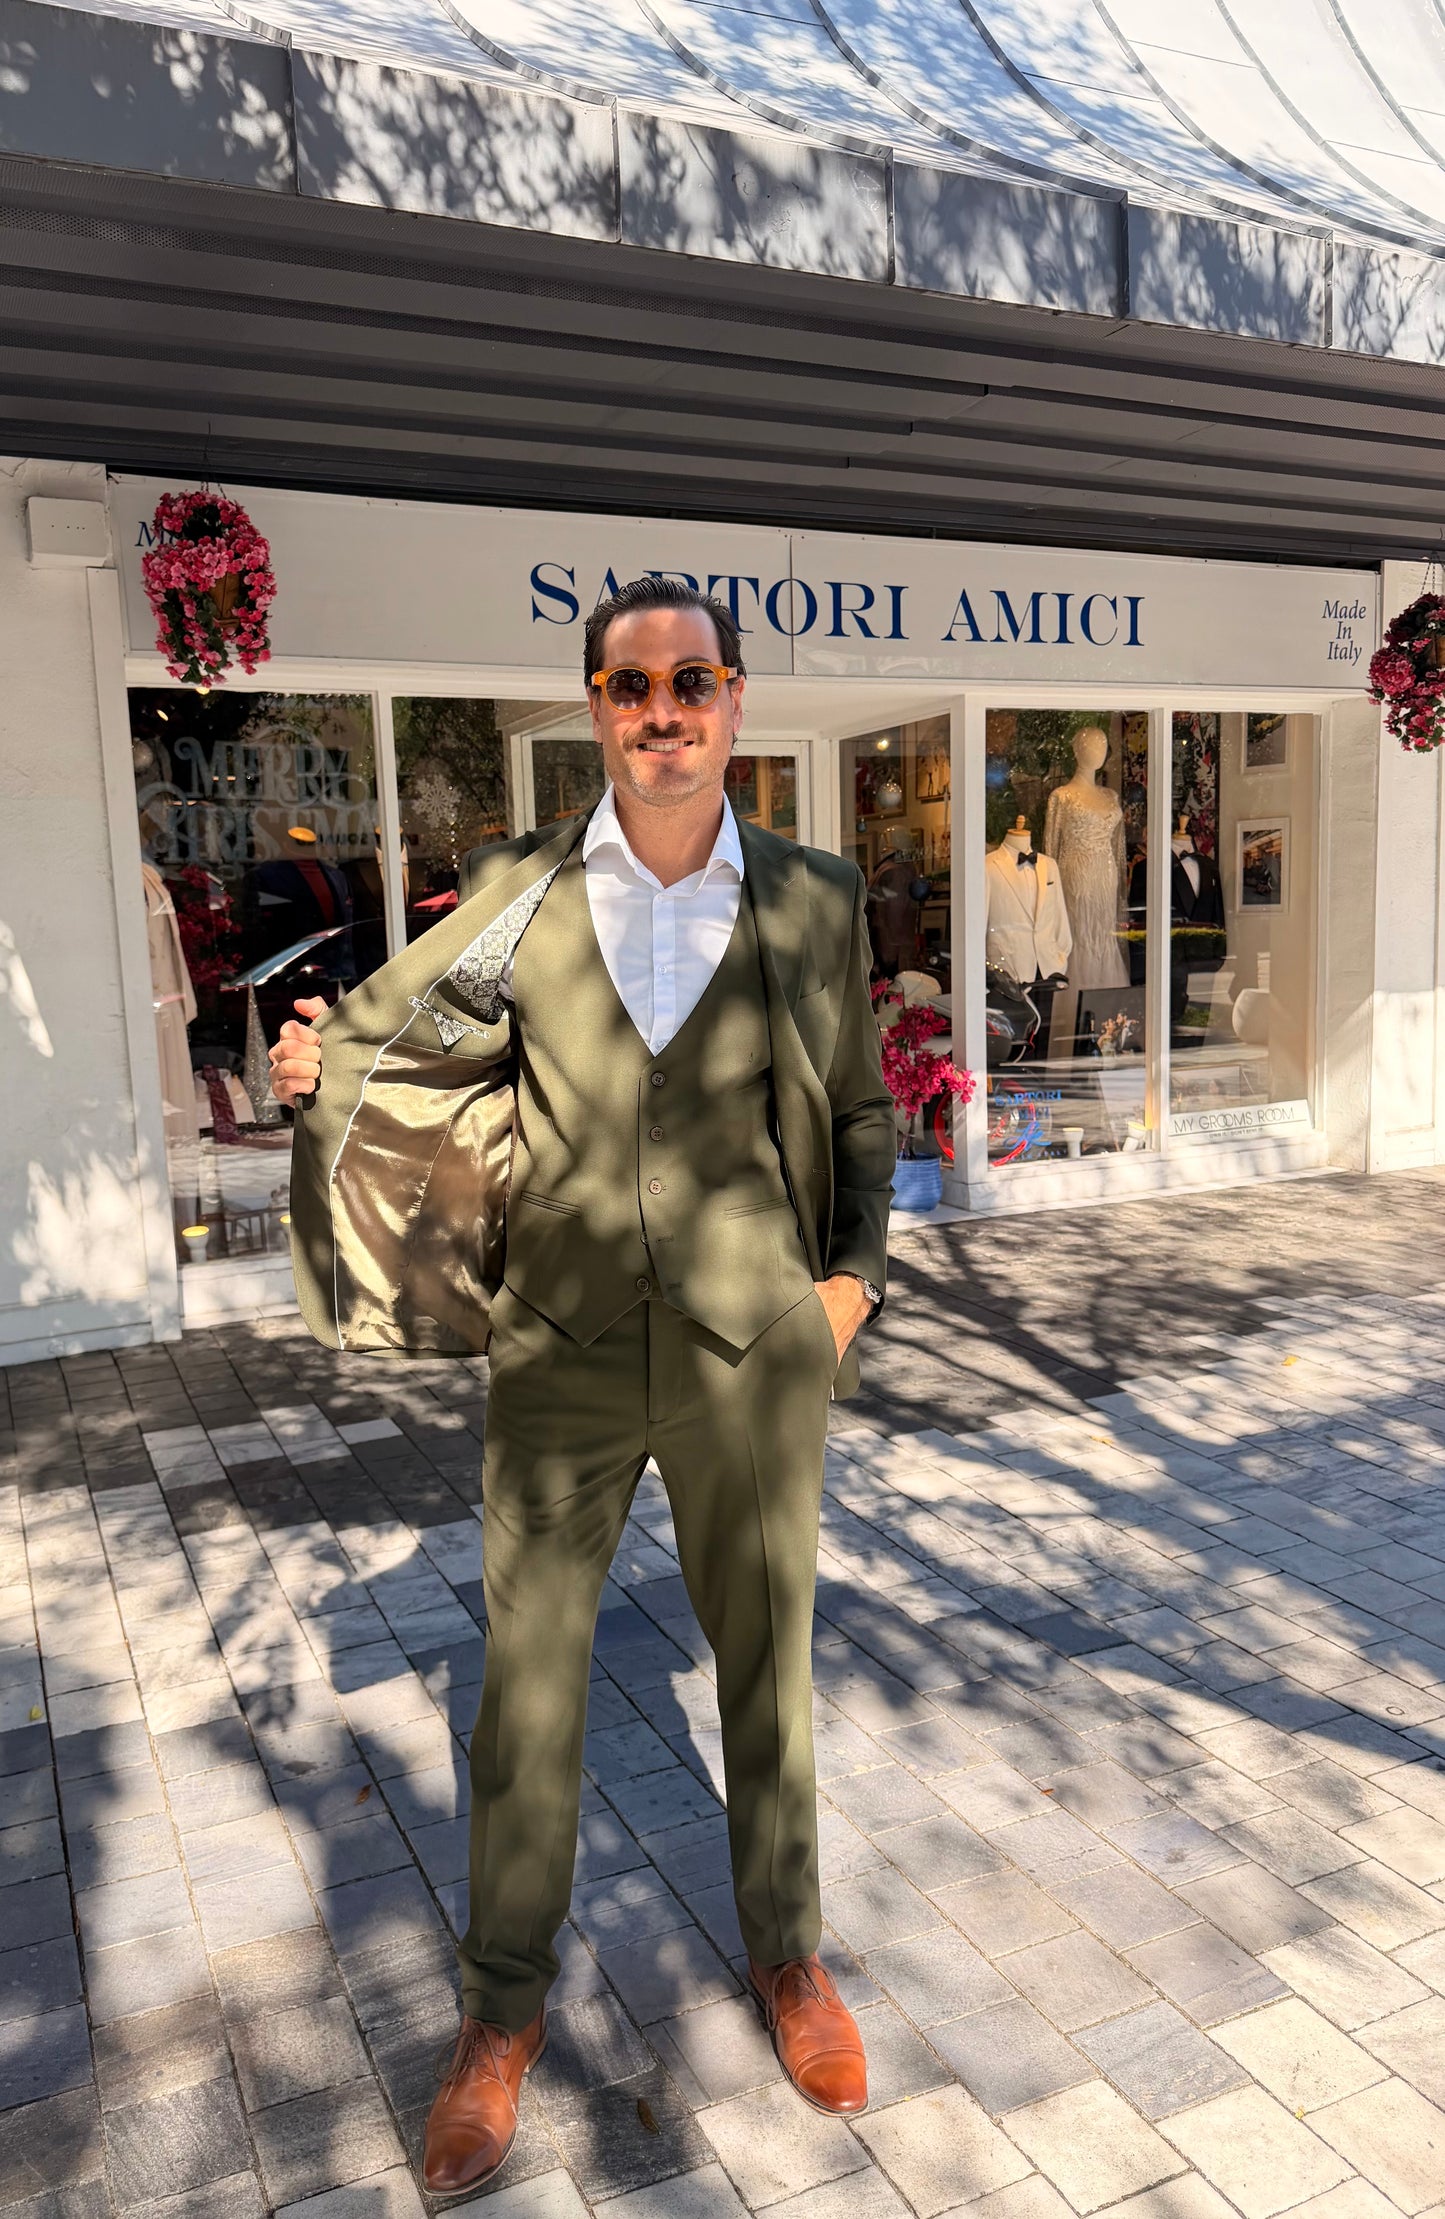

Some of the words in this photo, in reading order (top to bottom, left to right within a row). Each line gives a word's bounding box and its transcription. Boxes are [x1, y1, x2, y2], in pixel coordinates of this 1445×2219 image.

[940, 588, 1146, 647] AMICI
[1321, 599, 1367, 619] Made
[1336, 620, 1352, 640] In
[1327, 640, 1362, 667] Italy
[174, 729, 367, 806] MERRY
[995, 1089, 1062, 1107] SARTORI
[1174, 1118, 1194, 1133] MY
[1199, 1111, 1253, 1130] GROOMS
[1257, 1107, 1295, 1122] ROOM
